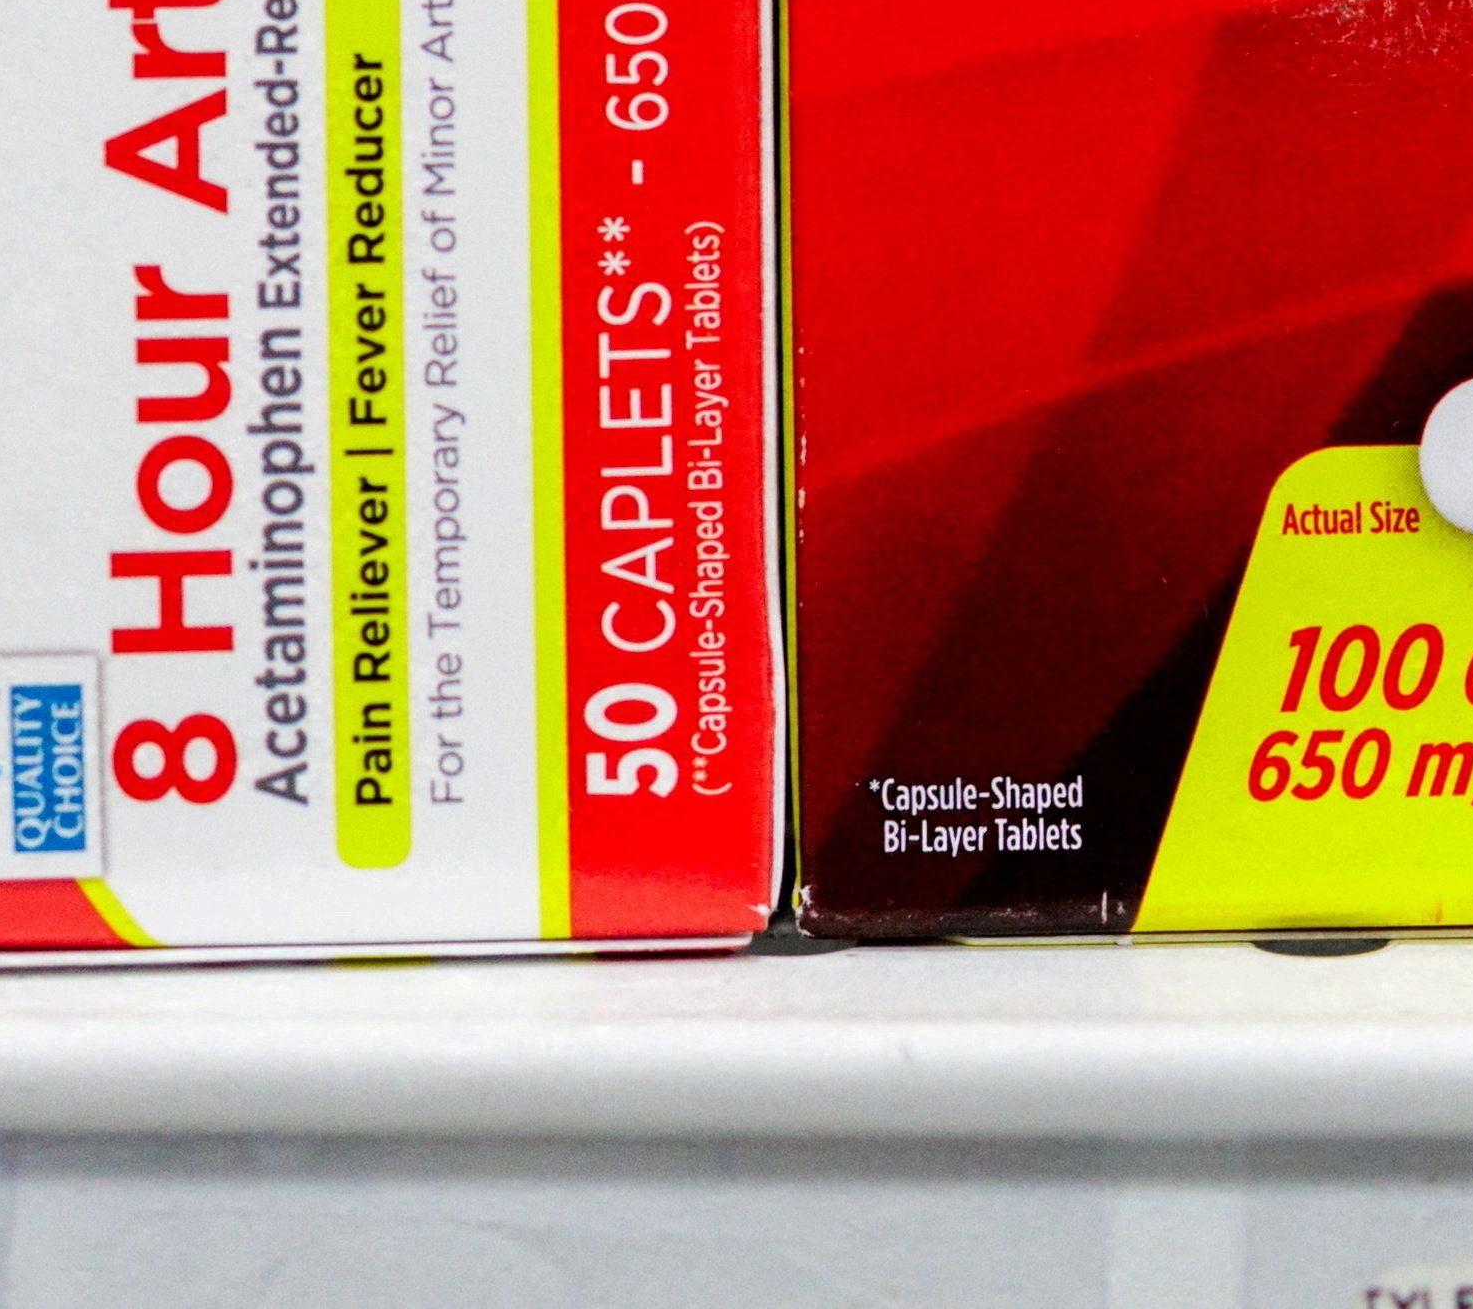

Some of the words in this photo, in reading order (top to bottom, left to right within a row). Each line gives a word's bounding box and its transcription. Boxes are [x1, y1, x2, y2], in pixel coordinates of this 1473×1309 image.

[605, 3, 668, 130] 650
[344, 53, 385, 264] Reducer
[421, 77, 455, 196] Minor
[421, 210, 456, 253] of
[684, 221, 724, 349] Tablets)
[349, 283, 387, 425] Fever
[421, 269, 458, 387] Relief
[110, 265, 234, 654] Hour
[688, 359, 729, 490] Bi-Layer
[247, 328, 315, 805] Acetaminophen
[427, 403, 467, 638] Temporary
[1282, 502, 1362, 535] Actual
[1370, 501, 1420, 533] Size
[350, 477, 390, 682] Reliever
[428, 653, 463, 720] the
[1281, 623, 1444, 712] 100
[13, 684, 48, 849] QUALITY
[50, 699, 82, 838] CHOICE
[112, 714, 237, 804] 8
[352, 703, 392, 805] Pain
[430, 734, 464, 804] For
[585, 683, 678, 797] 50
[1248, 728, 1391, 802] 650
[884, 820, 987, 857] Bi-Layer
[995, 818, 1082, 851] Tablets
